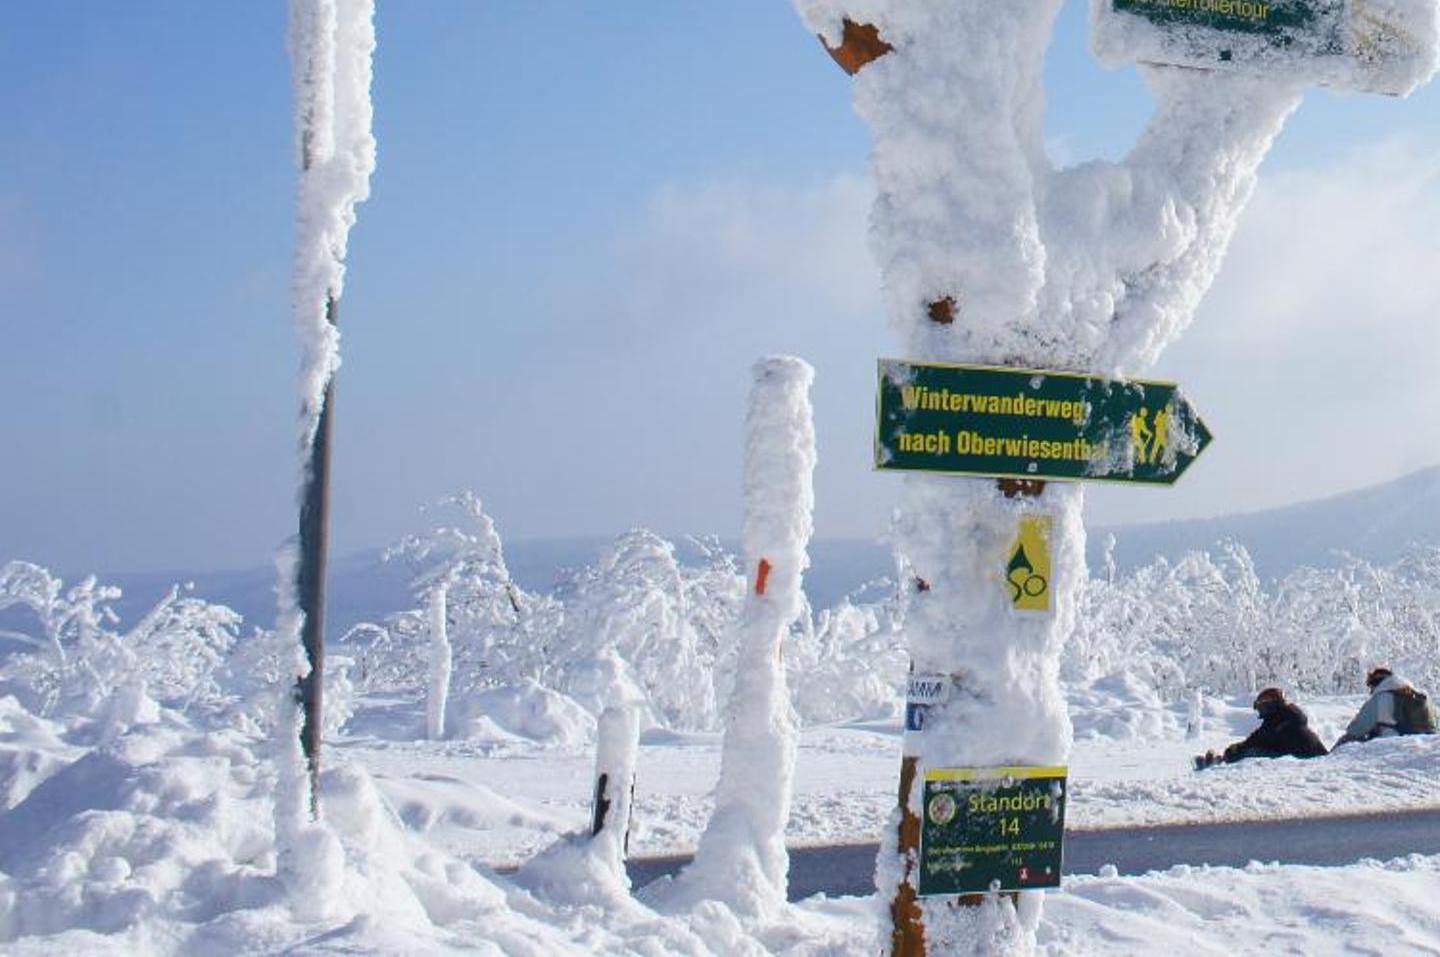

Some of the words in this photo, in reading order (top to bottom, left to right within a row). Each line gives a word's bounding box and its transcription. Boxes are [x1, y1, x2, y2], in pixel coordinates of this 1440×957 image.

[901, 386, 1086, 425] Winterwanderweg
[899, 431, 950, 455] nach
[968, 791, 1052, 813] Standort
[999, 817, 1020, 837] 14
